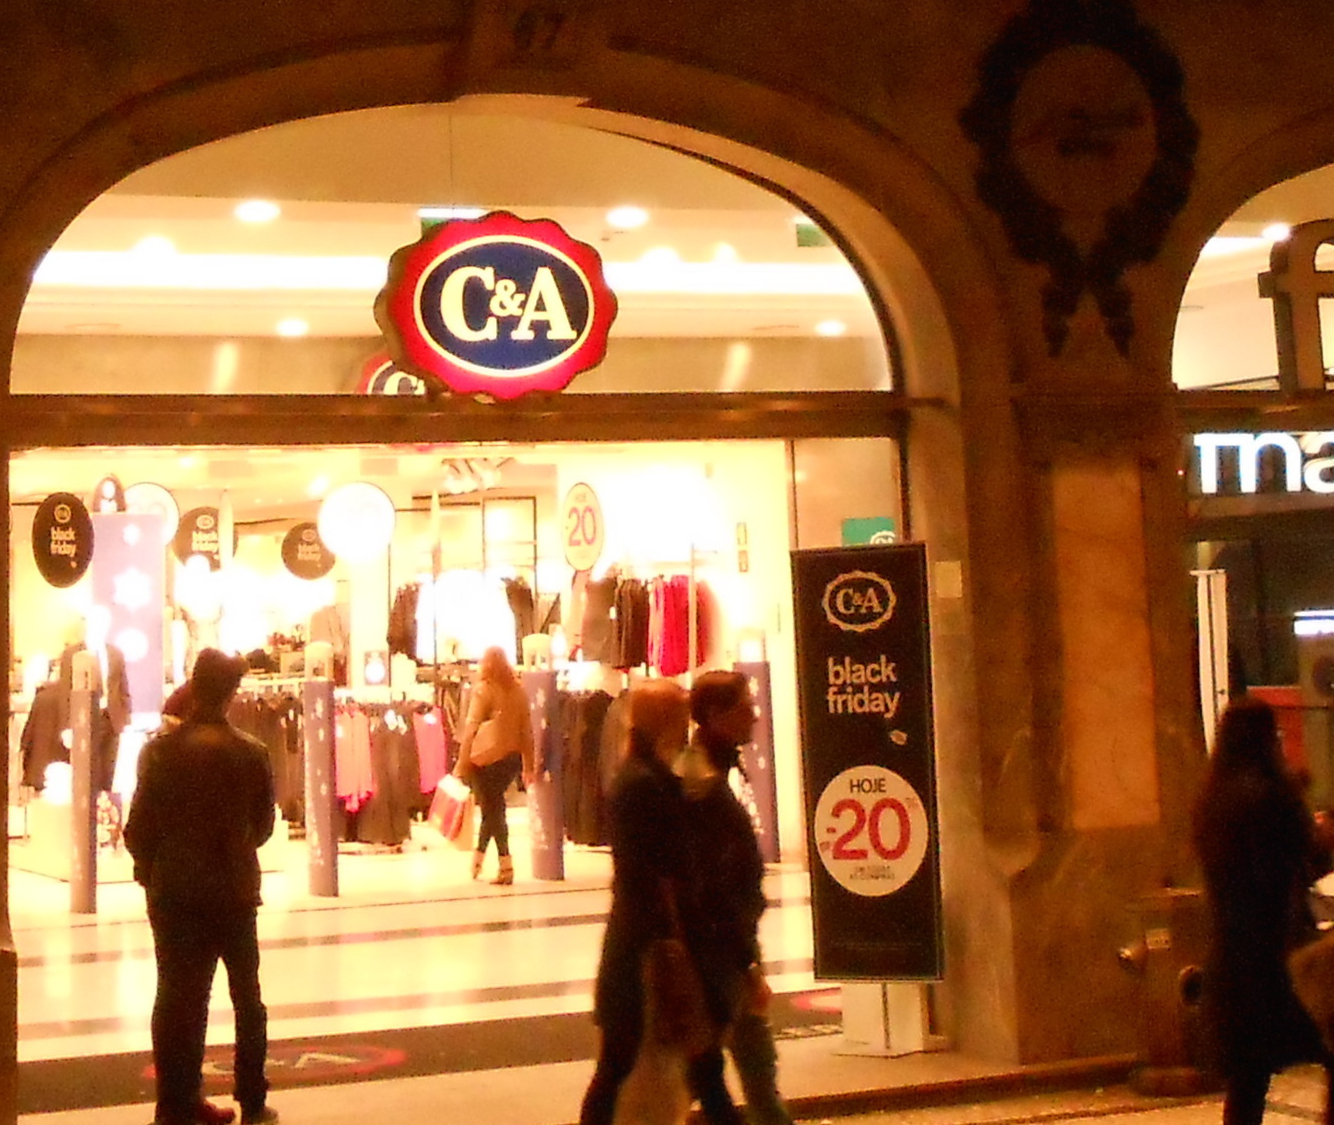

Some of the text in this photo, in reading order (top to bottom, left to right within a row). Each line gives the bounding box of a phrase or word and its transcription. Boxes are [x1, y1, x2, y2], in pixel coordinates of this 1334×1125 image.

[440, 266, 577, 341] C&A
[836, 587, 884, 615] C&A
[828, 656, 897, 683] black
[827, 686, 900, 719] friday
[850, 778, 886, 793] HOJE
